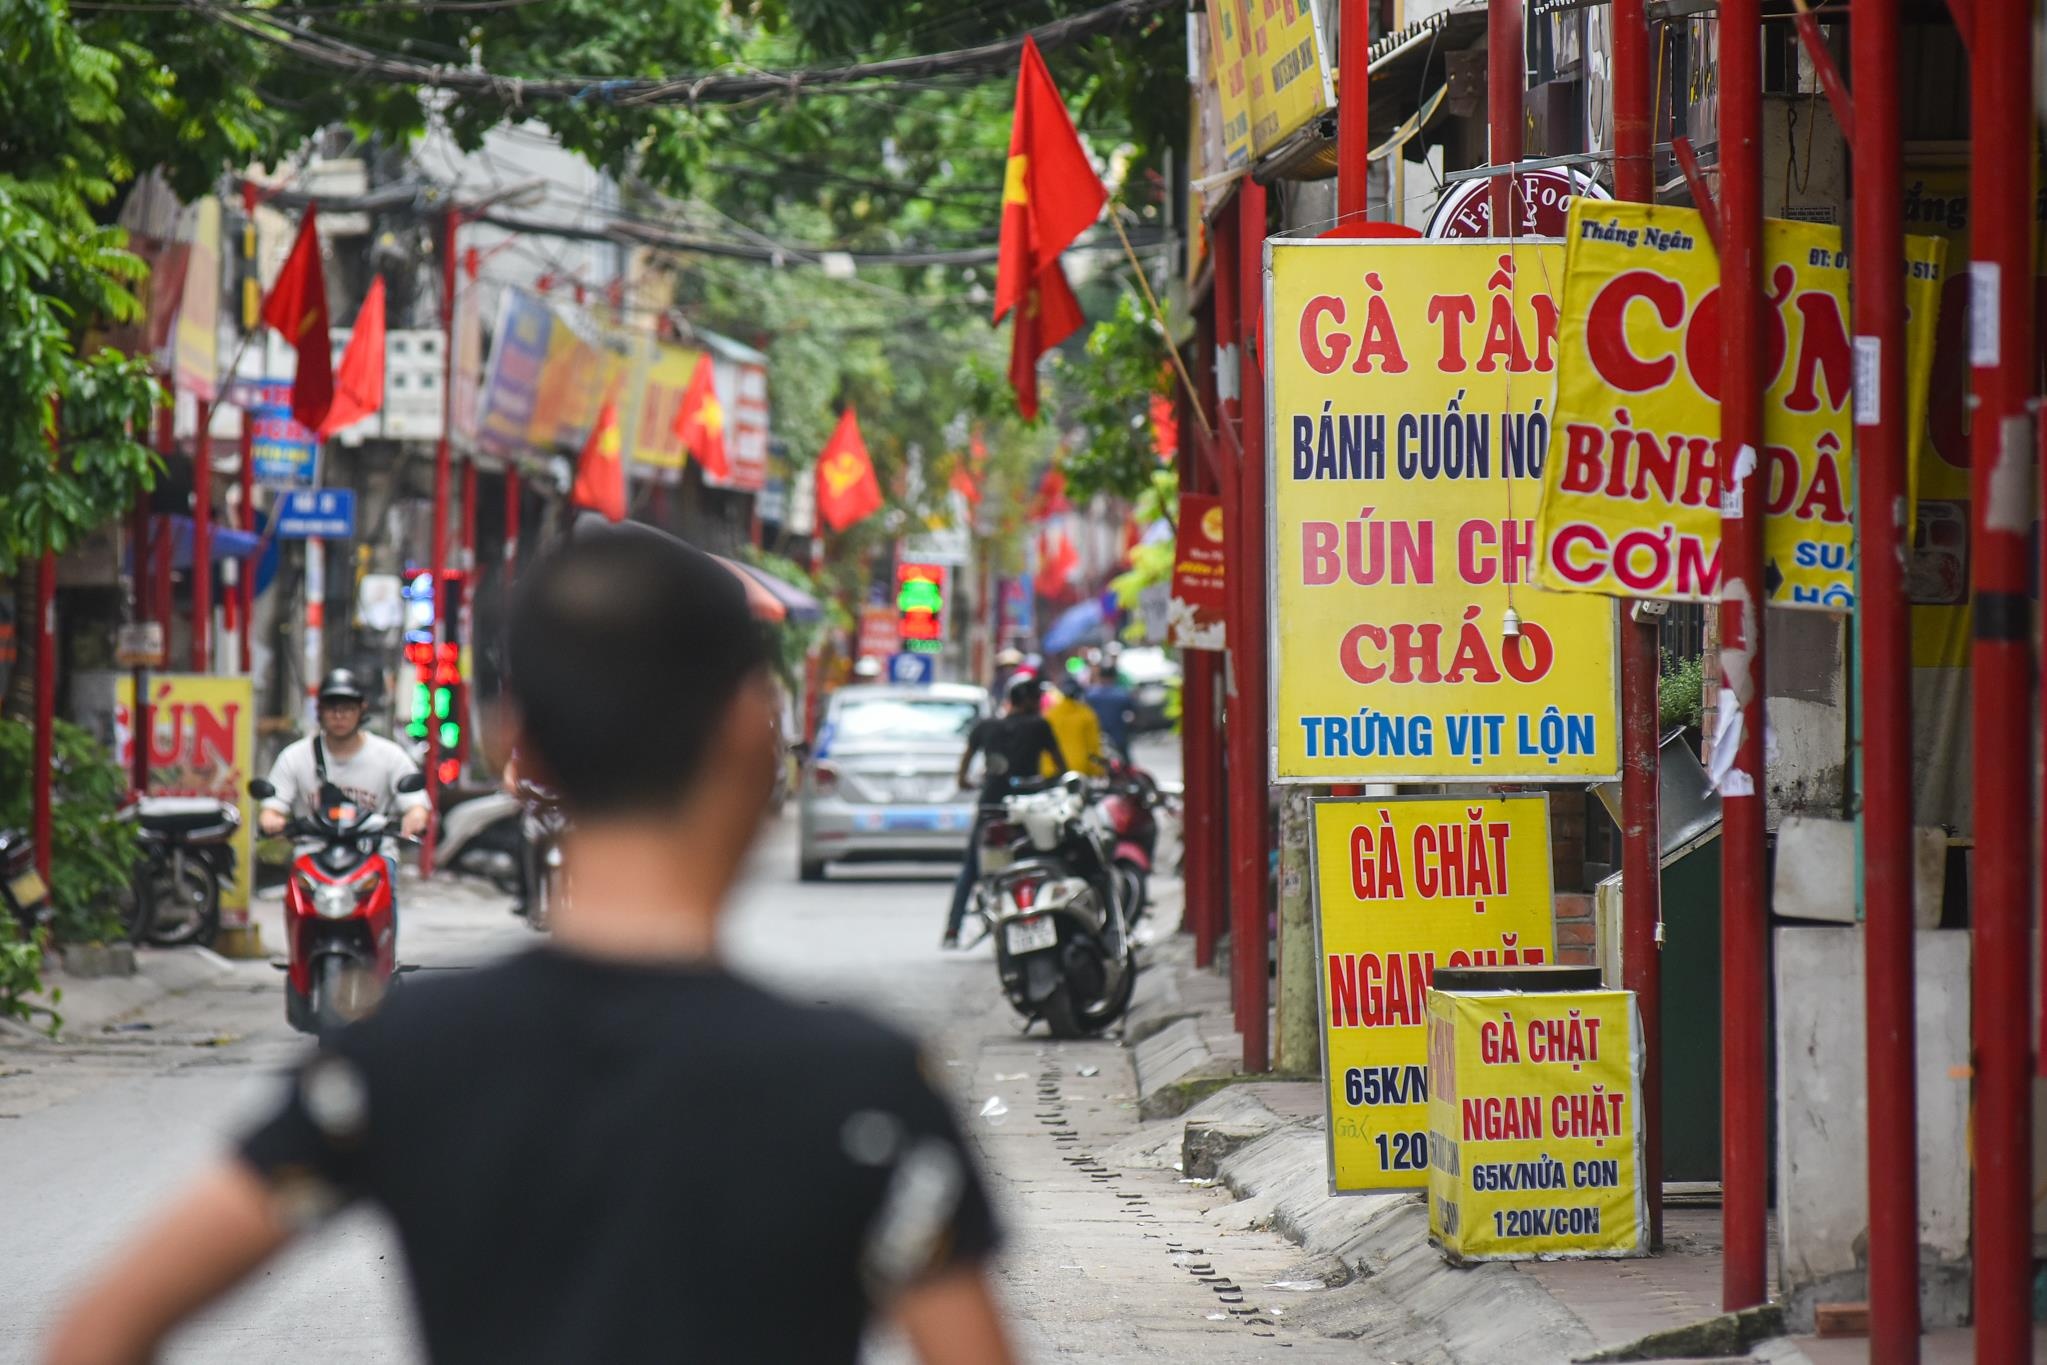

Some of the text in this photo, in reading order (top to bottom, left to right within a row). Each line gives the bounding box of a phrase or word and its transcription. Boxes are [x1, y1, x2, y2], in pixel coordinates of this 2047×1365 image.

[1523, 178, 1570, 213] Foo
[1581, 219, 1639, 248] Thắng
[1644, 228, 1694, 251] Ngân
[1299, 272, 1409, 374] GÀ
[1293, 390, 1547, 480] BÁNH CUỐN NÓ
[1560, 408, 1853, 523] BÌNH DÂ
[1302, 507, 1535, 585] BÚN CH
[1552, 526, 1721, 596] CƠM
[1340, 605, 1554, 683] CHÁO
[1301, 706, 1595, 764] TRỨNG VỊT LỘN
[1350, 808, 1510, 913] GÀ CHẶT
[1329, 953, 1434, 1028] NGAN
[1481, 1012, 1520, 1064] GÀ
[1528, 1010, 1600, 1071] CHẶT
[1462, 1085, 1625, 1147] NGAN CHẶT
[1472, 1154, 1566, 1192] 65K/NỬA
[1573, 1160, 1618, 1188] CON
[1493, 1207, 1600, 1238] 120K/CON
